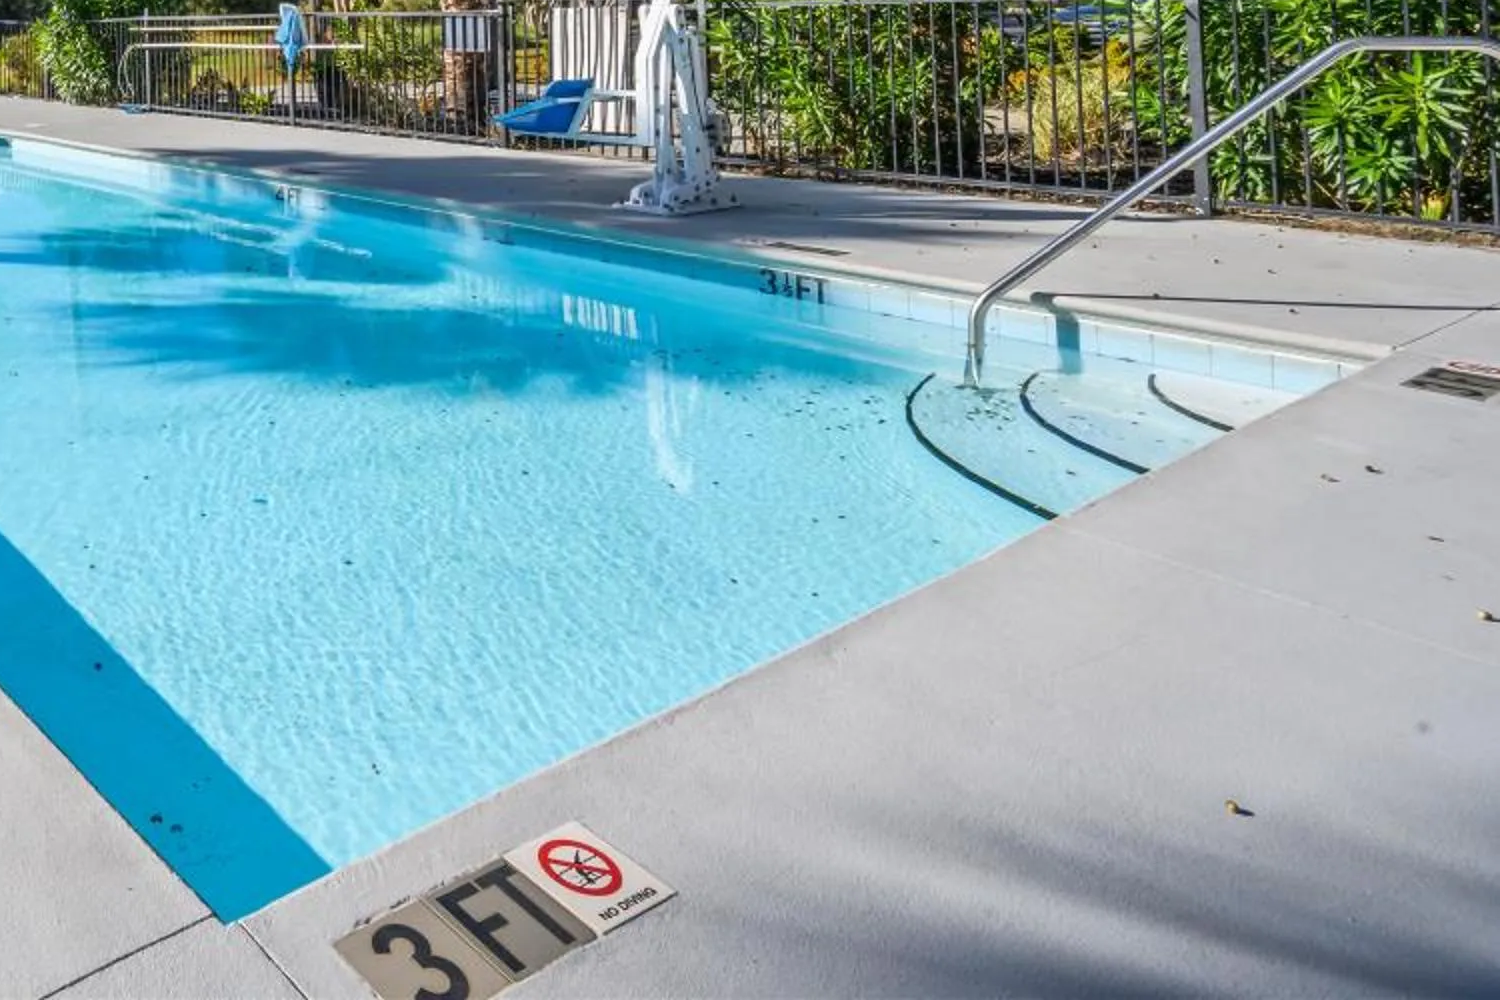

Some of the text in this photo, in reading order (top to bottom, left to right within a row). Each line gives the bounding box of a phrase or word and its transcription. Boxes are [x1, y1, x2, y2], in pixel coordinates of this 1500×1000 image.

[796, 274, 829, 305] FT
[598, 887, 658, 922] NO DIVING
[371, 861, 578, 1000] 3 FT
